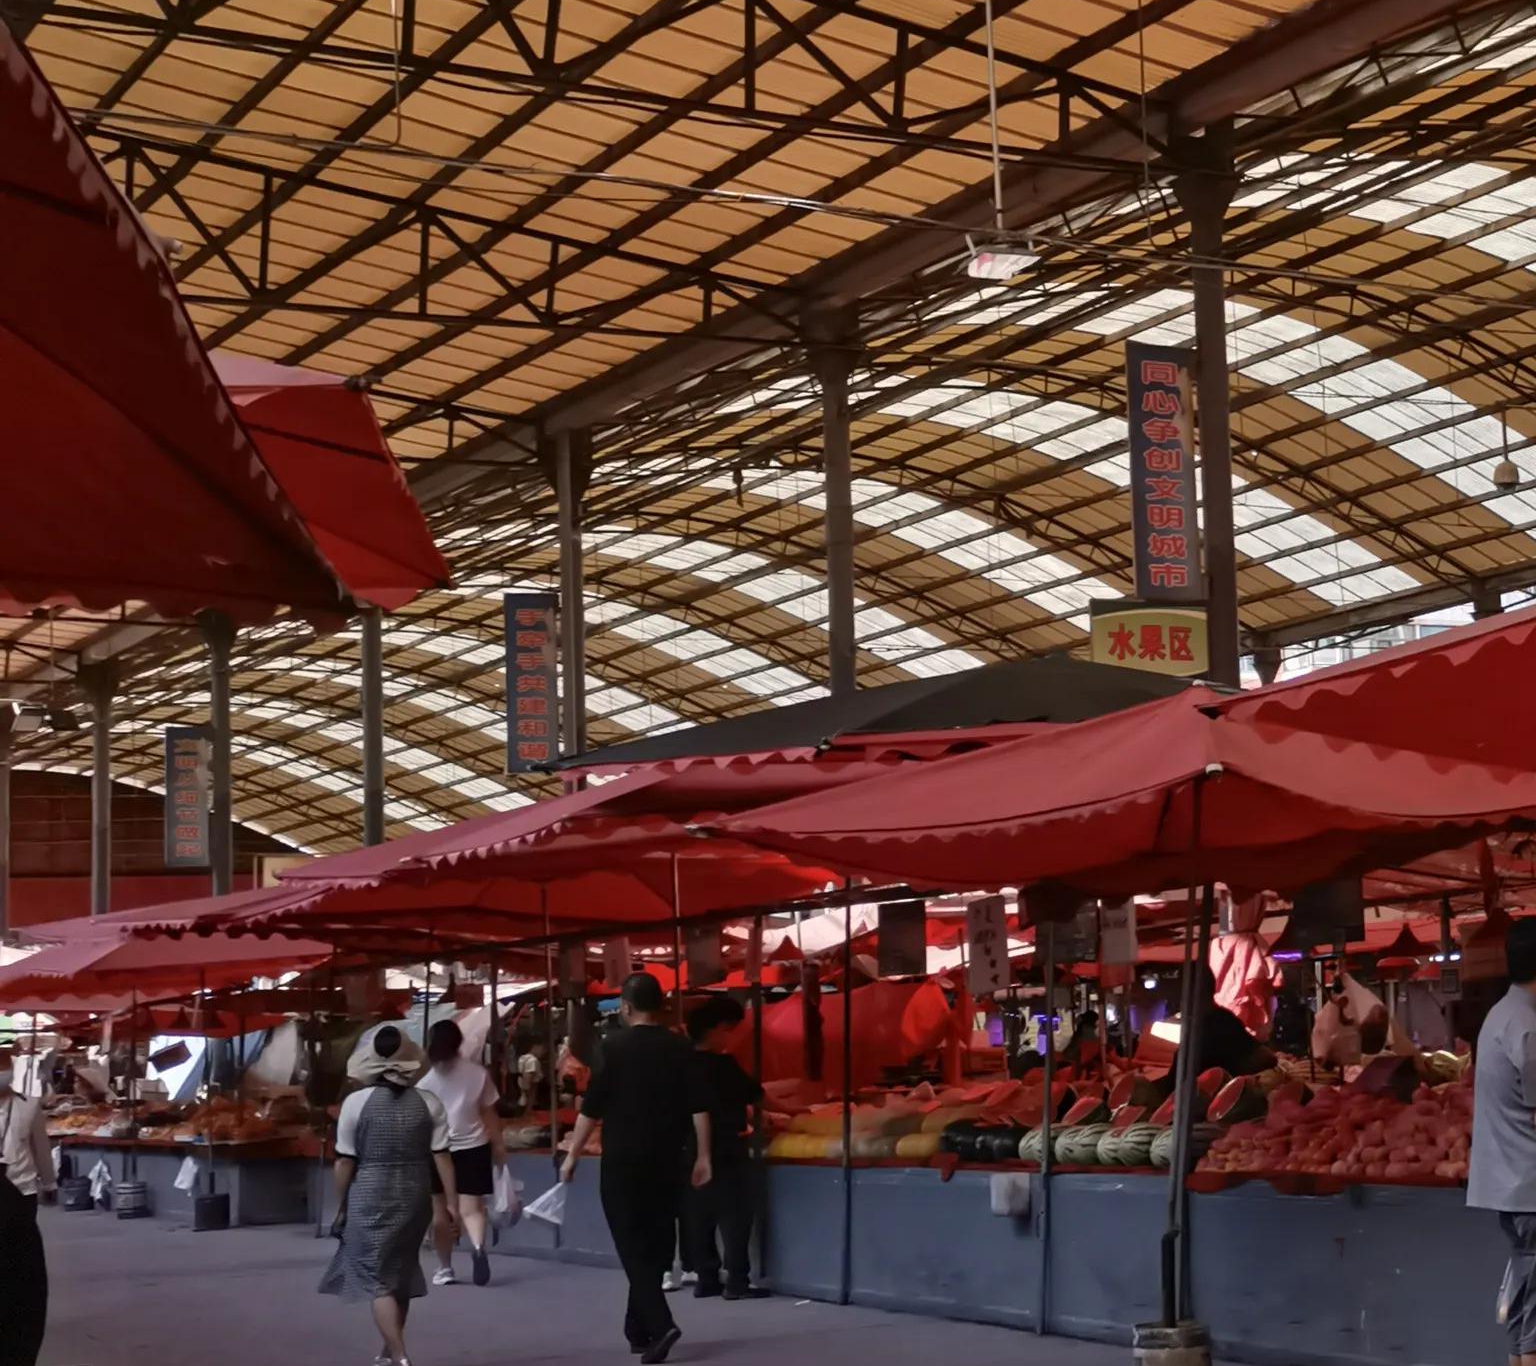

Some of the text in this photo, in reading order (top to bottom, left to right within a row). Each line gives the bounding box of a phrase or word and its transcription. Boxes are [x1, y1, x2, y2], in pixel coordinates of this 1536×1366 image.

[1139, 360, 1189, 588] 同心争创文明城市
[1106, 622, 1195, 662] 水果区
